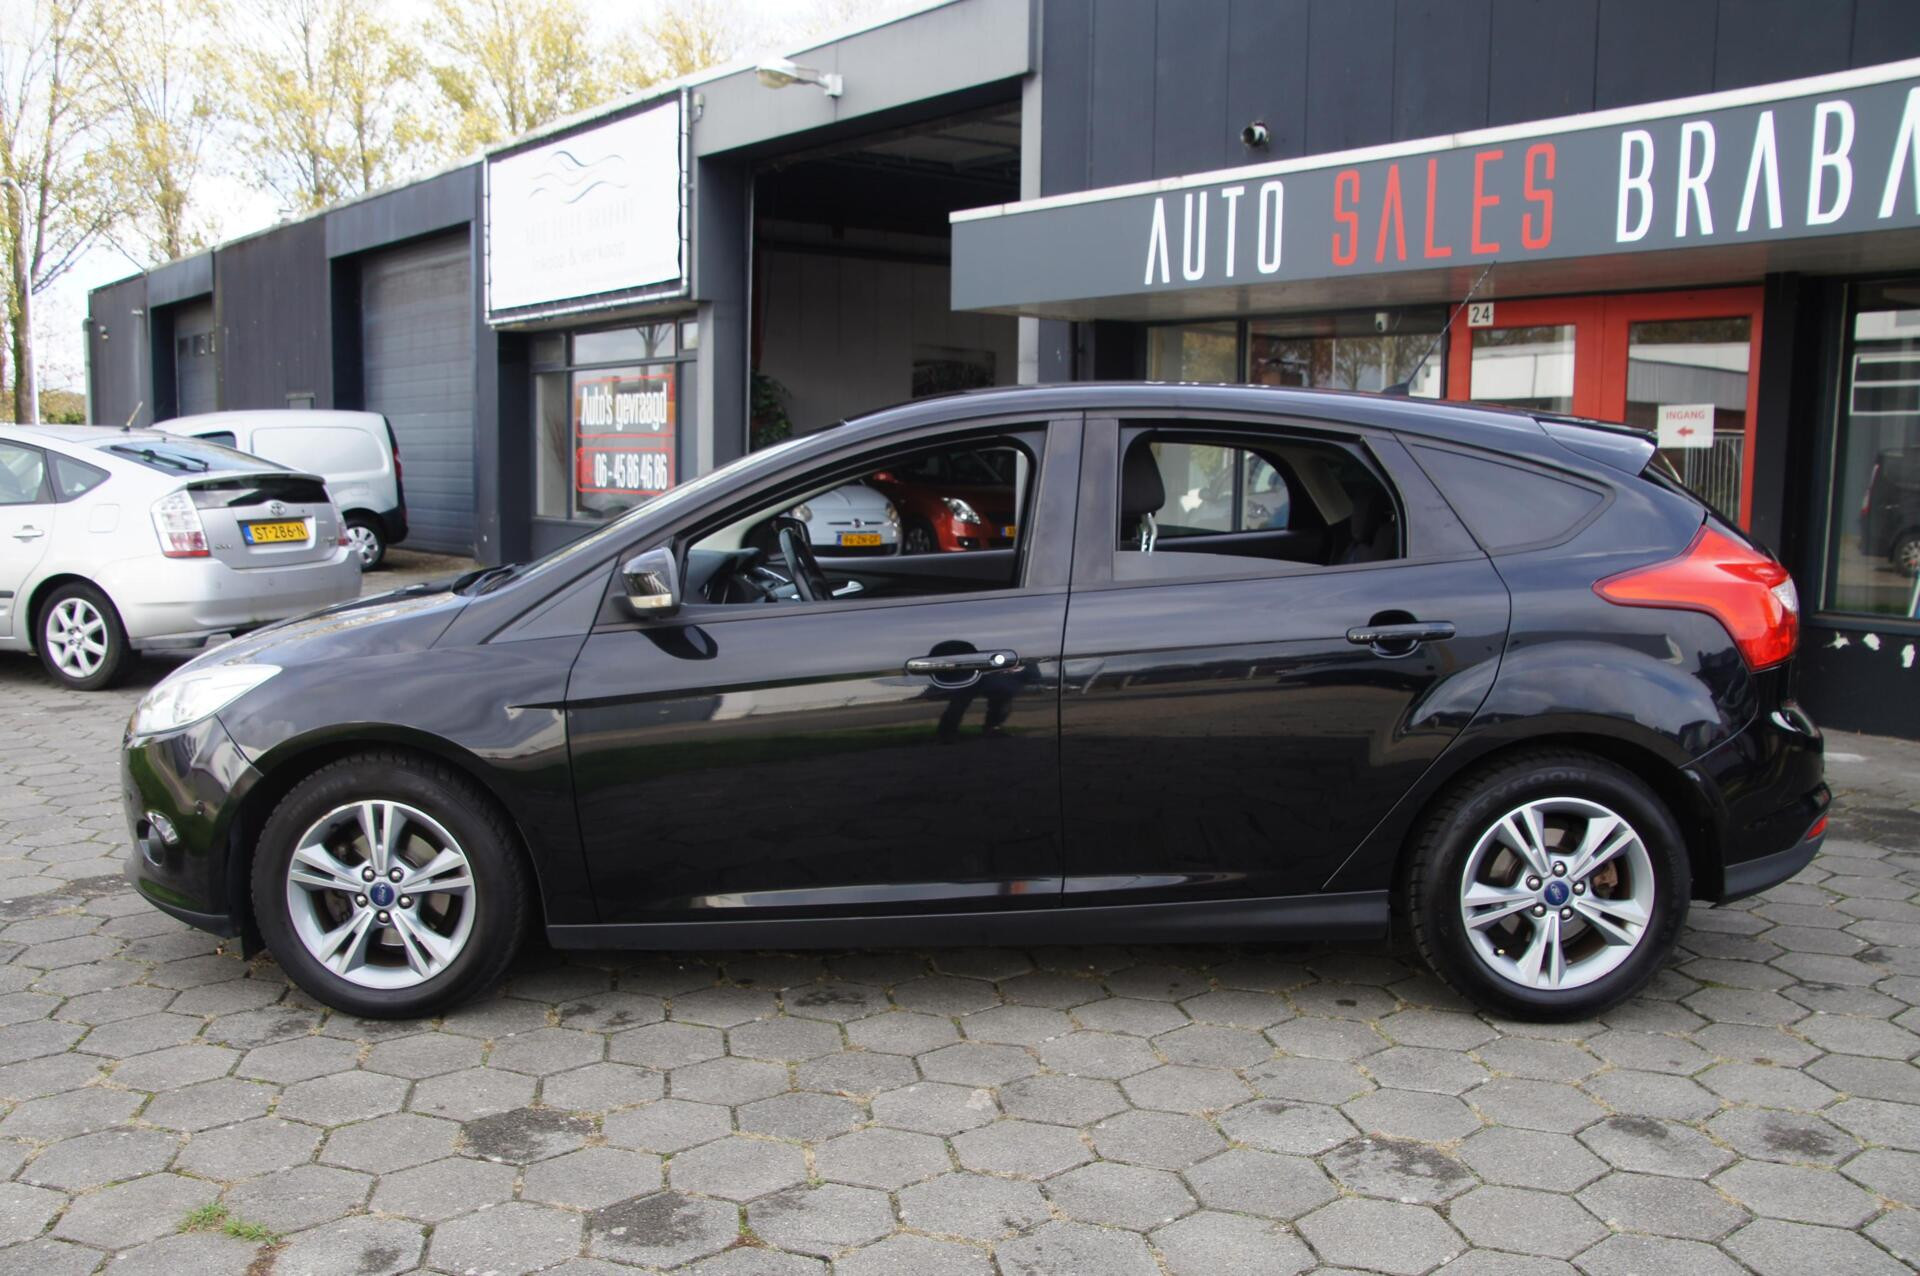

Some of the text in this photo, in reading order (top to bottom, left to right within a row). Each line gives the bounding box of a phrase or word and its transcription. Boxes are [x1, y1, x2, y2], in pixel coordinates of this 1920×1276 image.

[1144, 87, 1920, 285] AUTO SALES BRABA
[1472, 305, 1490, 323] 24
[581, 382, 668, 432] Auto's gevraagd
[1666, 410, 1705, 420] INGANG
